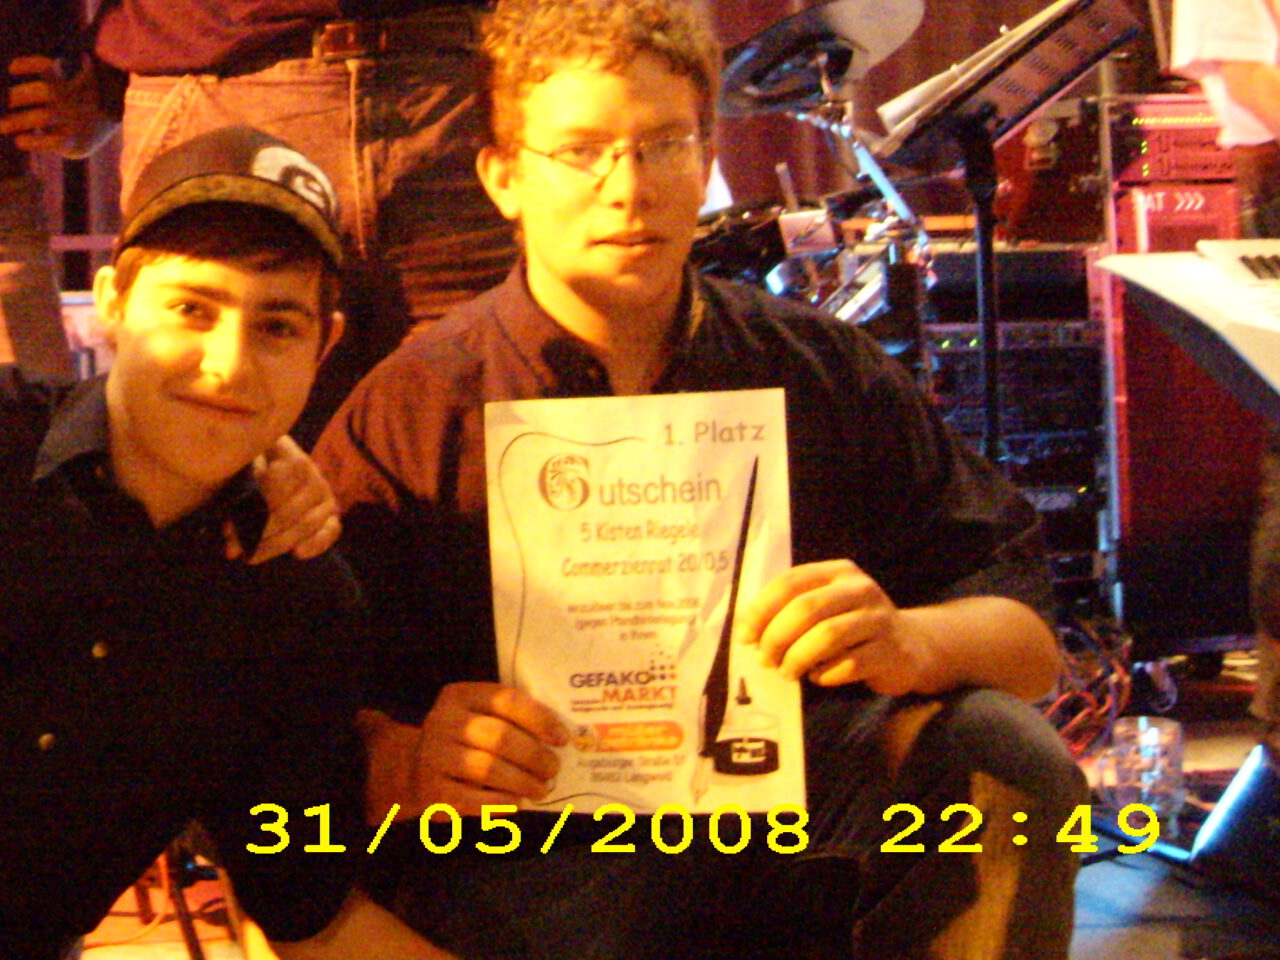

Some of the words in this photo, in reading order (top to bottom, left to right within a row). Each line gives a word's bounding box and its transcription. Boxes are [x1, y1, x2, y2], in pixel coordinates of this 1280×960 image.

[663, 423, 684, 446] 1.
[694, 420, 766, 444] Platz
[538, 453, 722, 512] Gutschein
[580, 522, 592, 542] 5
[570, 671, 651, 689] GEFAKO
[602, 685, 678, 703] MARKT
